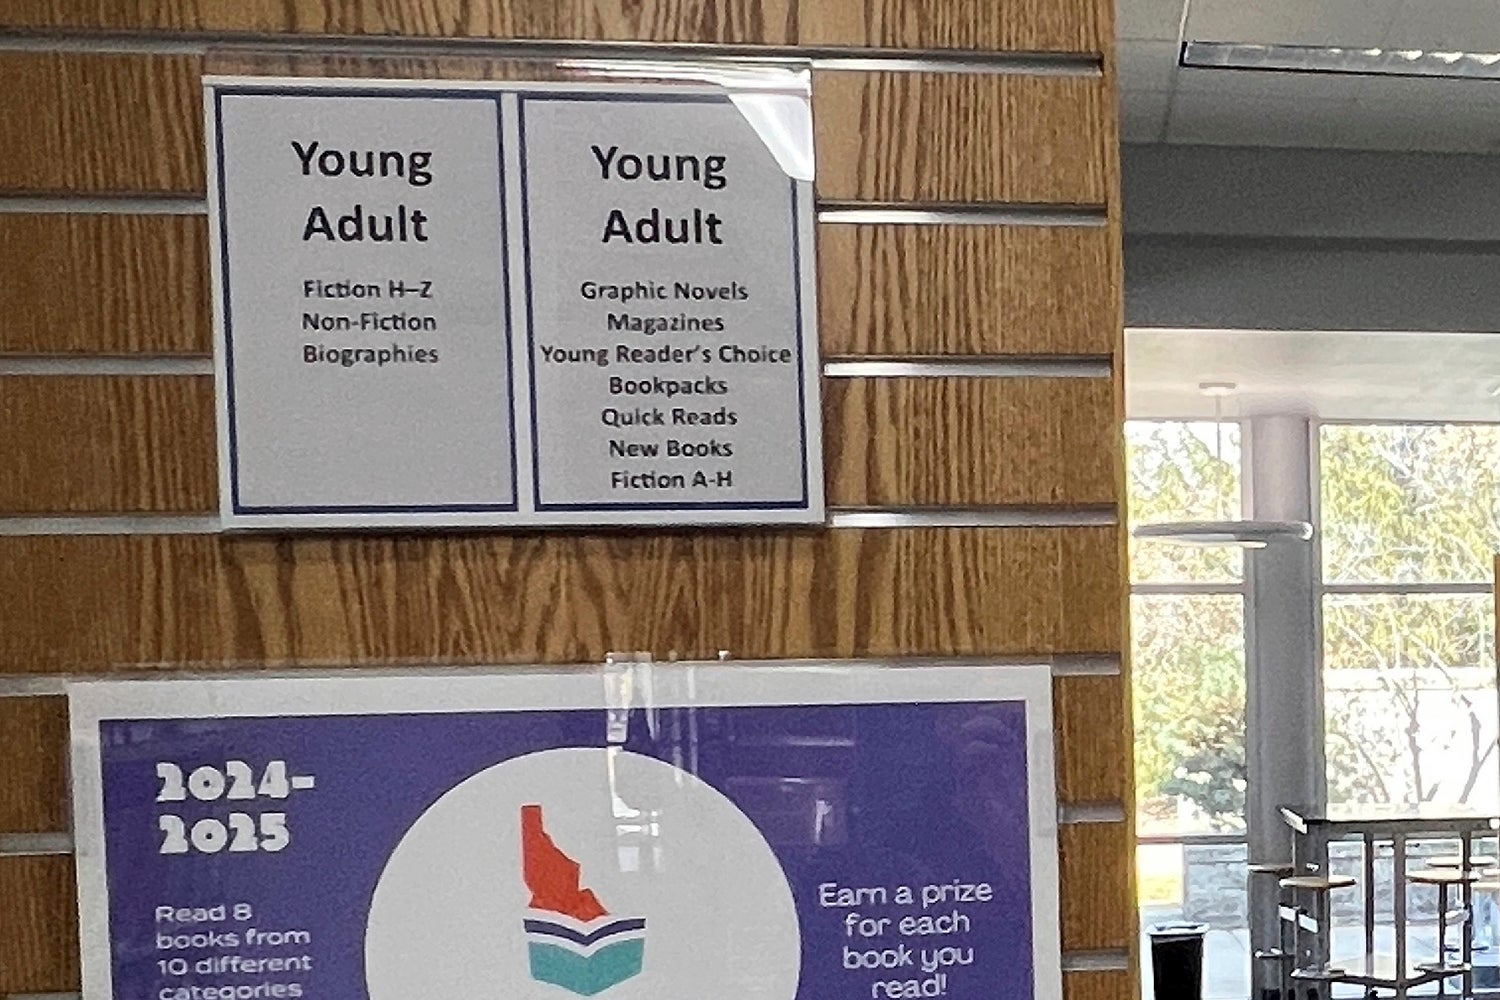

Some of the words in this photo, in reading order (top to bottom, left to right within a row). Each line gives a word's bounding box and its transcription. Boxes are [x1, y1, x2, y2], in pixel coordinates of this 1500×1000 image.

[292, 141, 433, 185] Young
[591, 146, 727, 189] Young
[302, 206, 429, 242] Adult
[602, 209, 723, 244] Adult
[304, 281, 380, 299] Fiction
[581, 282, 667, 301] Graphic
[674, 282, 748, 300] Novels
[302, 313, 436, 331] Non-Fiction
[607, 314, 724, 334] Magazines
[303, 345, 438, 365] Biographies
[540, 346, 609, 365] Young
[616, 345, 711, 363] Reader’s
[718, 345, 791, 363] Choice
[609, 376, 728, 396] Bookpacks
[601, 408, 665, 428] Quick
[672, 408, 737, 427] Reads
[609, 441, 658, 457] New
[667, 440, 733, 457] Books
[611, 471, 684, 489] Fiction
[692, 472, 732, 488] A-H
[156, 760, 315, 801] 2024-
[159, 813, 289, 853] 2025
[818, 882, 888, 907] Earn
[895, 886, 913, 906] a
[922, 879, 993, 908] prize
[156, 906, 225, 922] Read
[233, 904, 251, 920] 8
[845, 912, 891, 937] for
[900, 909, 971, 934] each
[156, 933, 239, 949] books
[246, 928, 311, 945] from
[157, 959, 187, 976] 10
[195, 954, 312, 974] different
[843, 943, 913, 970] book
[922, 947, 974, 973] you
[872, 973, 947, 1000] read!
